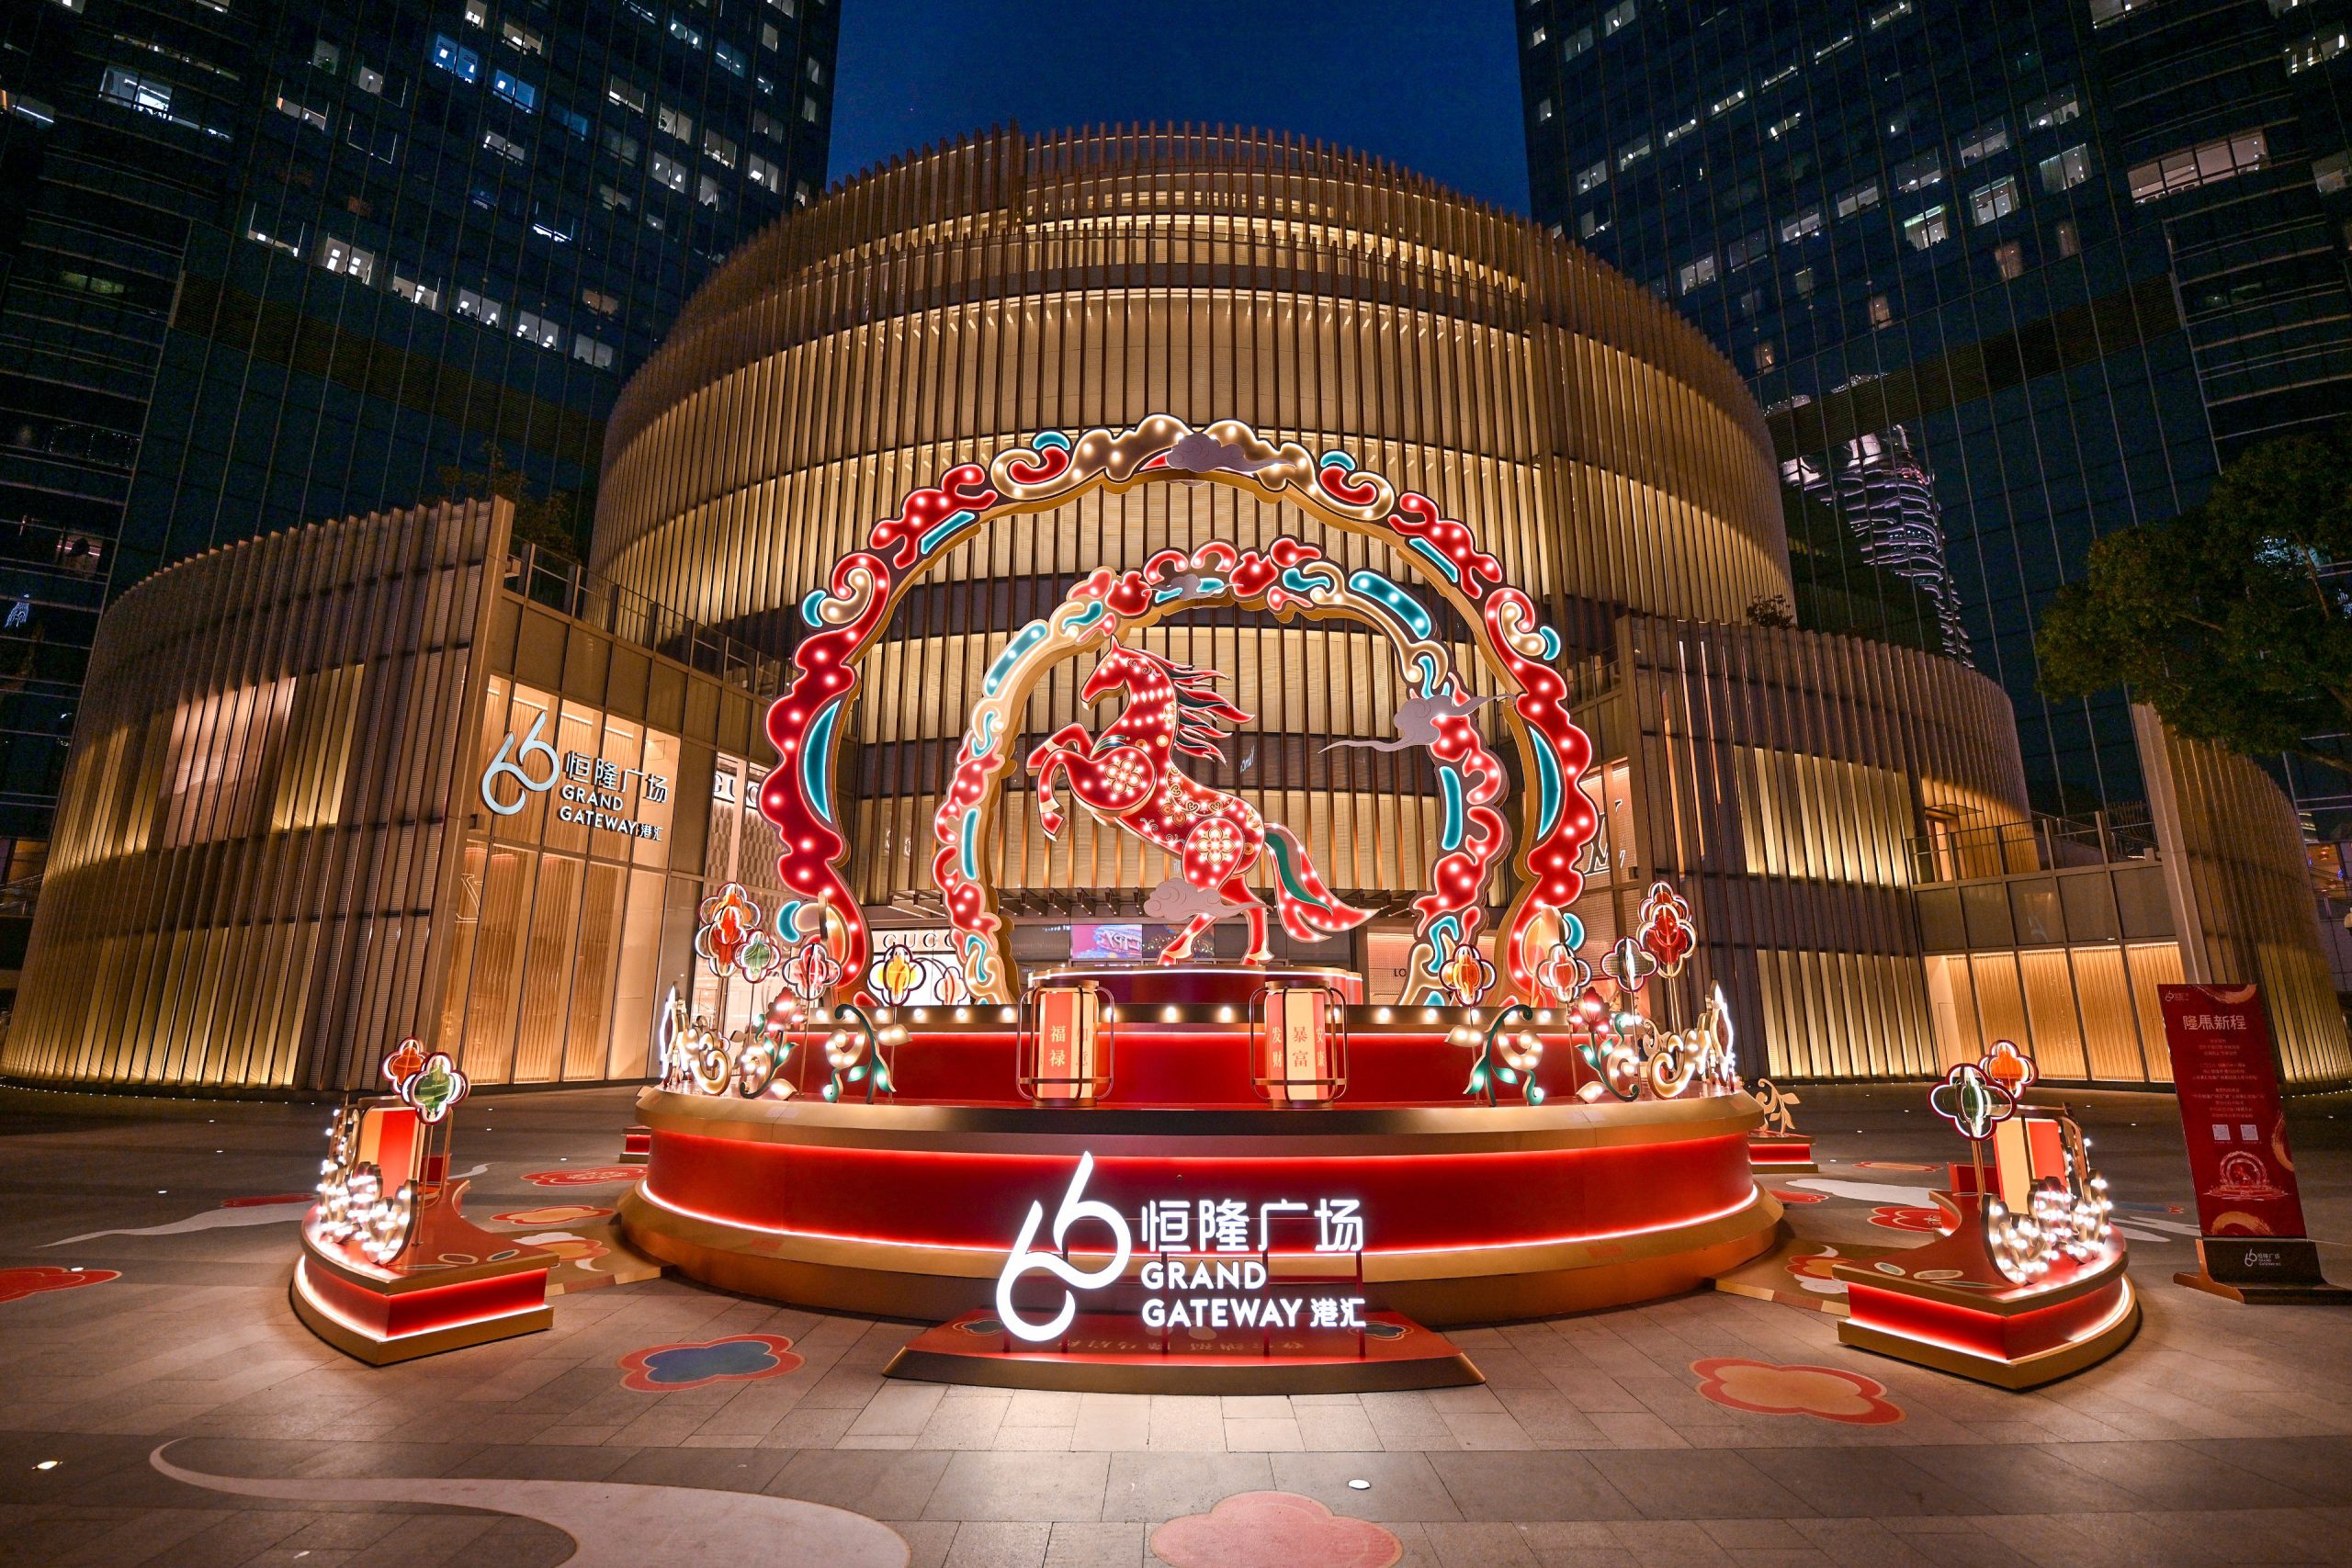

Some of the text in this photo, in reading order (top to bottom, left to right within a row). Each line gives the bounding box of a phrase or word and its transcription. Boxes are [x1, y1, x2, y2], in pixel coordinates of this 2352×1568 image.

[562, 784, 624, 811] GRAND
[566, 750, 670, 804] 恒隆广场
[560, 806, 664, 841] GATEWAY 港汇
[1050, 1025, 1067, 1066] 福禄
[1272, 1026, 1283, 1068] 发财
[1292, 1026, 1308, 1068] 暴富
[1141, 1198, 1364, 1253] 恒隆广场
[1140, 1260, 1267, 1290] GRAND
[1142, 1297, 1367, 1328] GATEWAY 港汇
